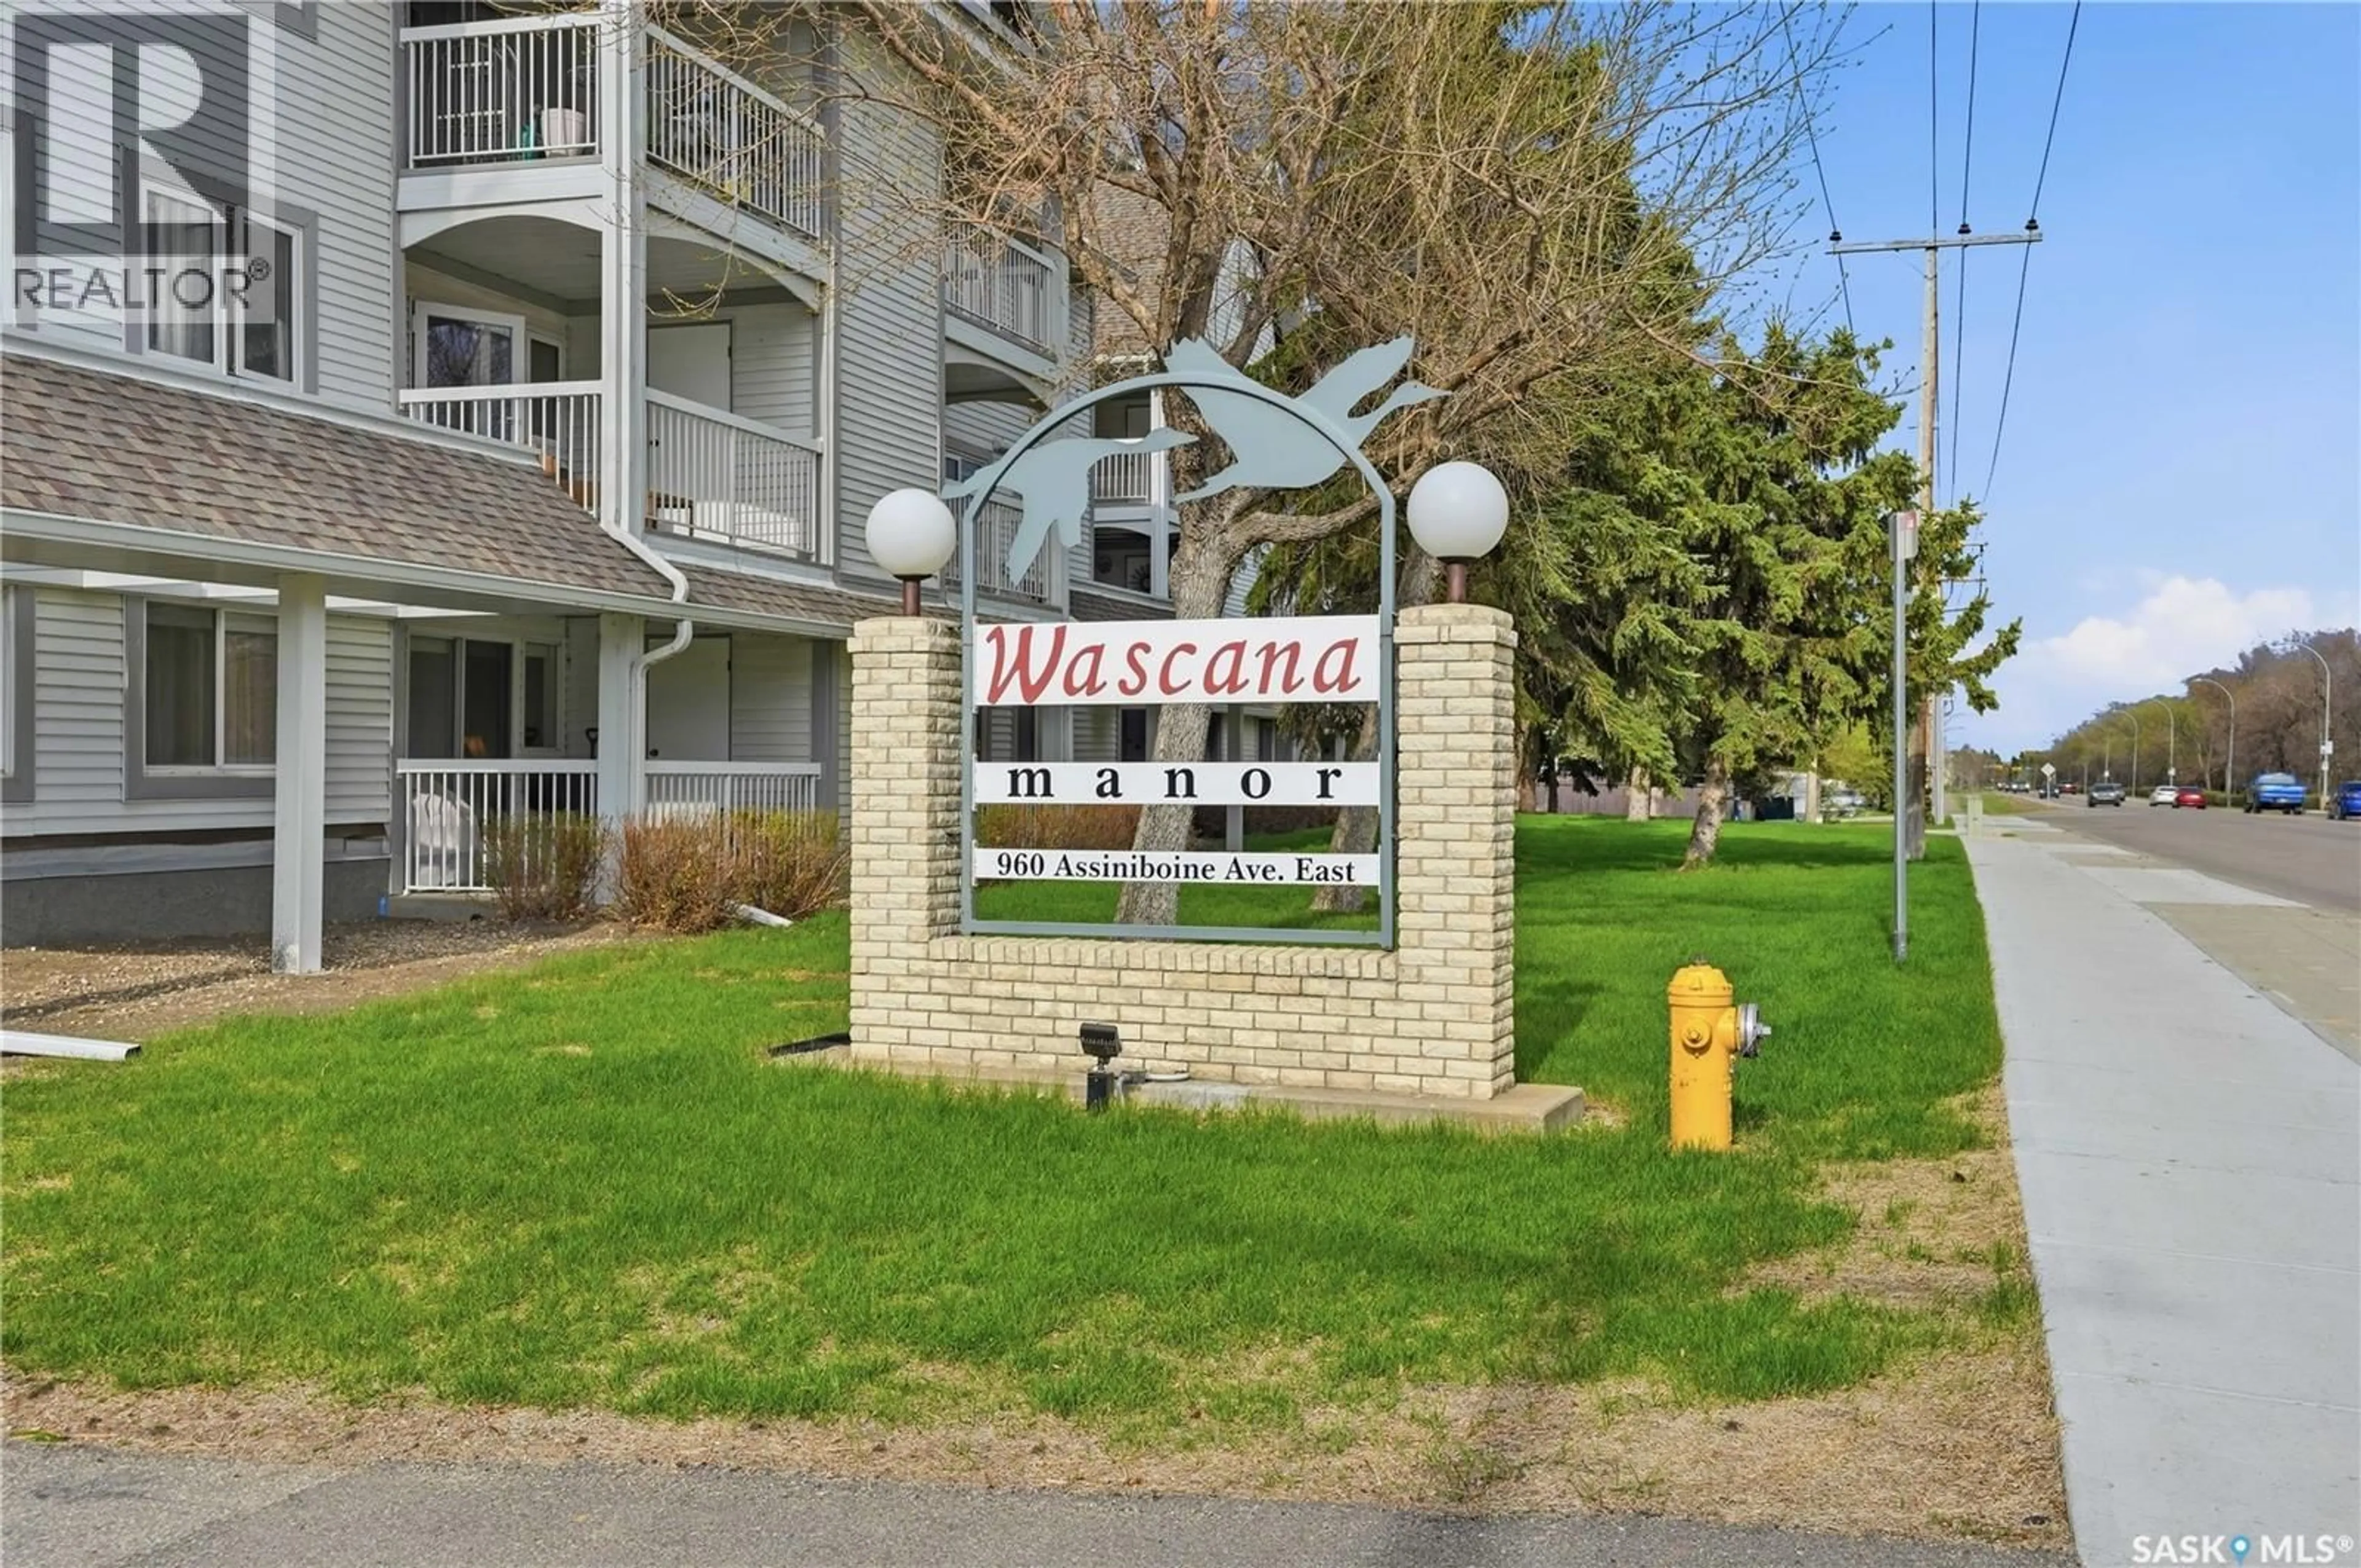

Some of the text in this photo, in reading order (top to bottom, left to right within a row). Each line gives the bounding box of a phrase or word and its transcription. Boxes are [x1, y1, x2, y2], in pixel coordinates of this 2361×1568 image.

[986, 624, 1361, 704] Wascana
[1007, 766, 1342, 799] manor
[997, 853, 1355, 882] 960 Assiniboine Ave. East
